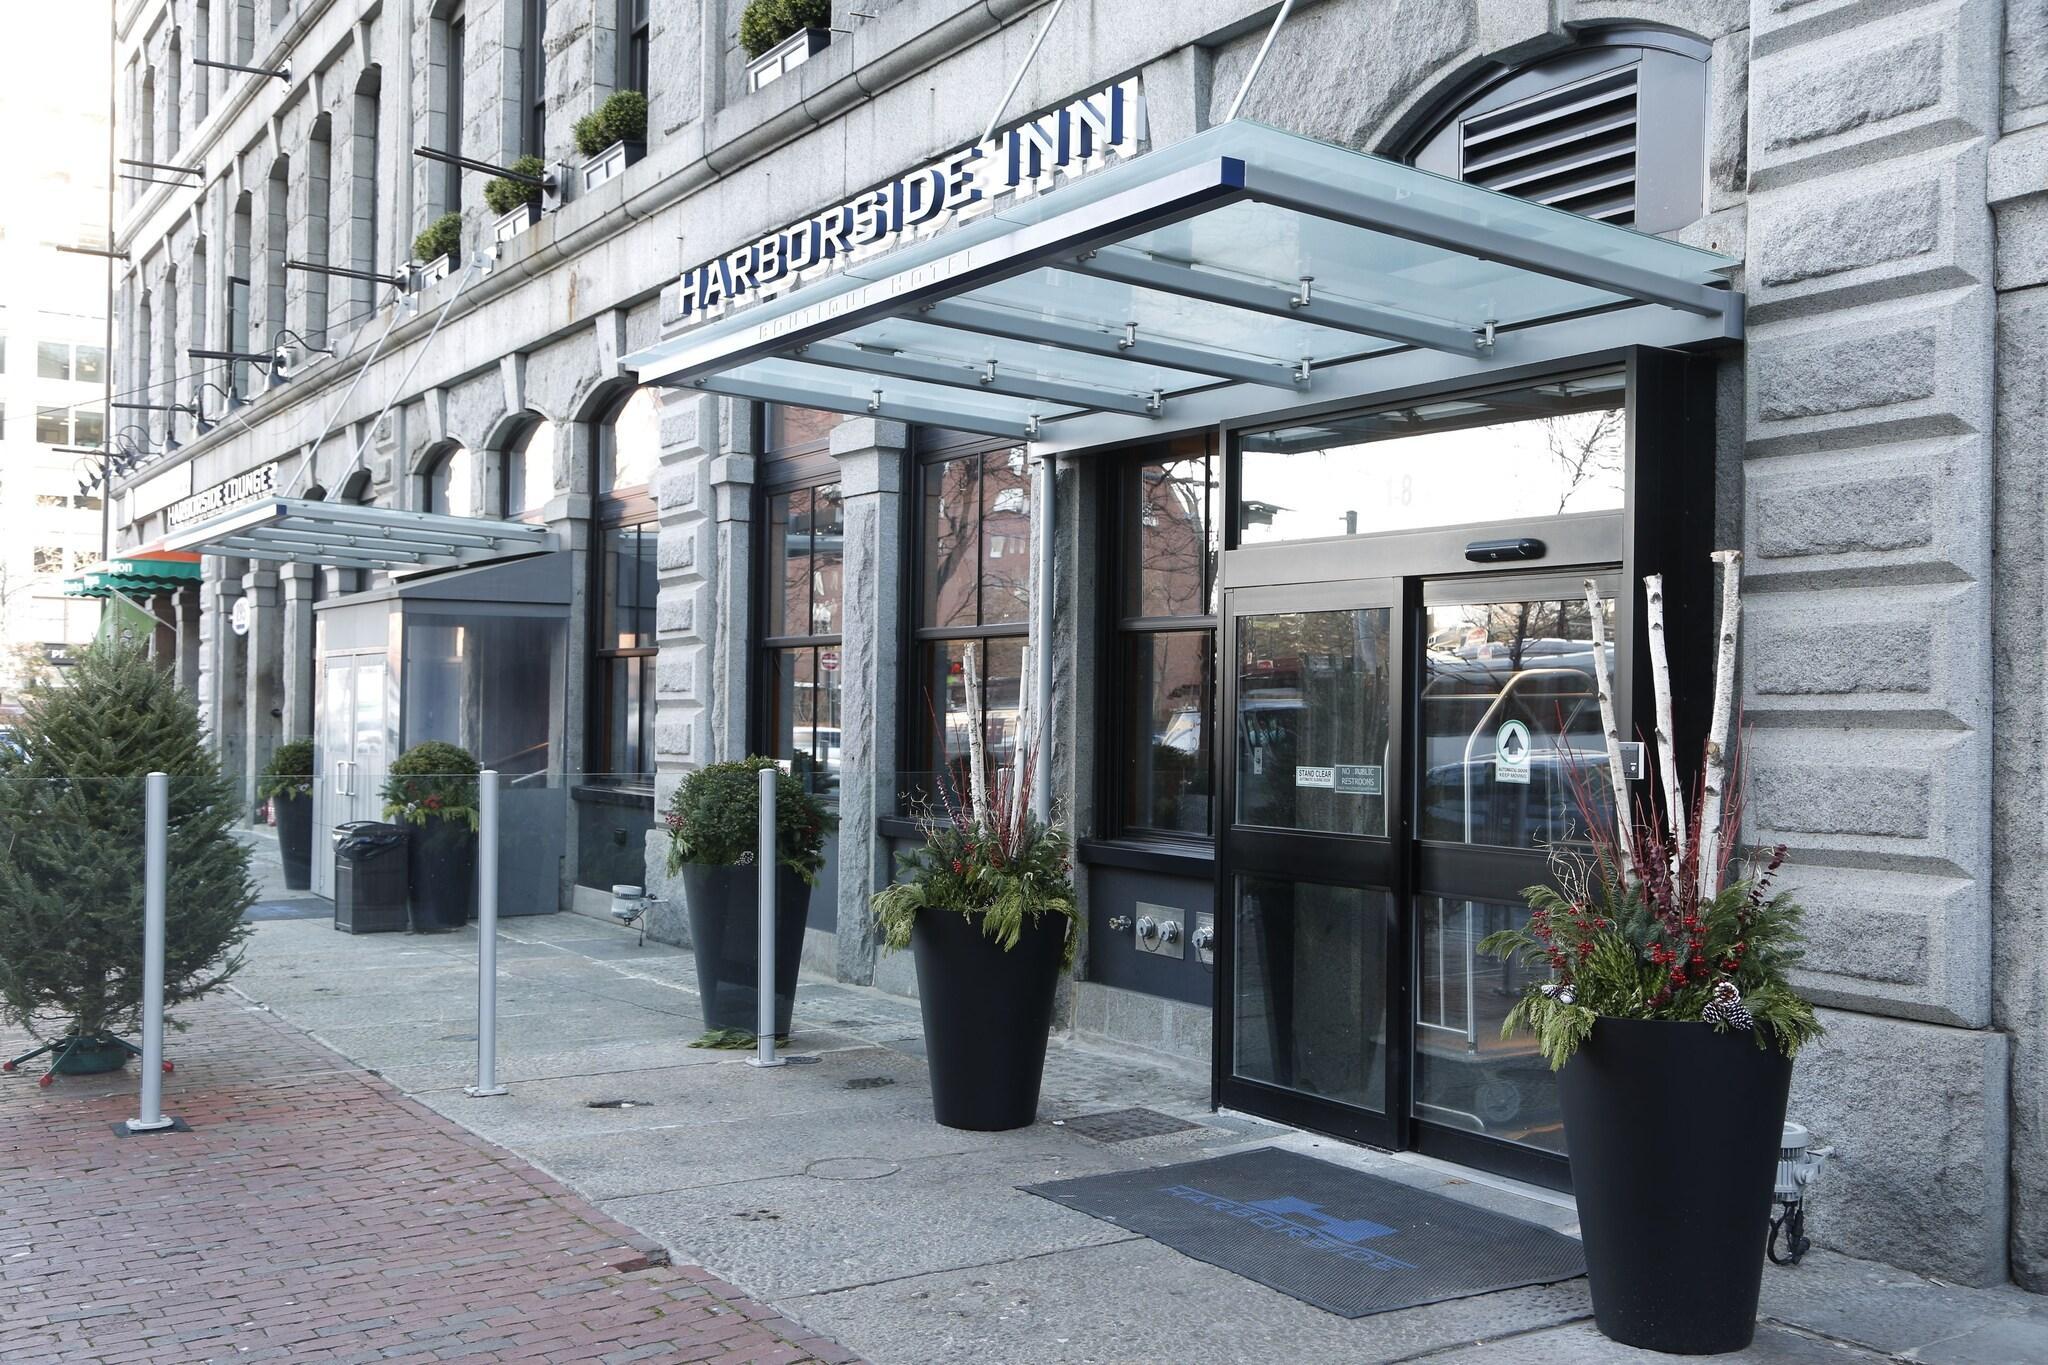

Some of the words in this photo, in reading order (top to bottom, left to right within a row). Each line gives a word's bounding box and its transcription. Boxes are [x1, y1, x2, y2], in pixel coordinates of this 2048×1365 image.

[679, 147, 983, 315] HARBORSIDE
[1002, 85, 1125, 188] INN
[758, 288, 875, 340] BOUTIQUE
[891, 250, 978, 294] HOTEL
[168, 485, 225, 527] HARBORSIDE
[225, 465, 272, 502] LOUNGE
[1315, 770, 1331, 778] CLEAR
[1341, 767, 1351, 776] NO
[1354, 768, 1375, 776] PUBLIC
[1341, 777, 1375, 786] RESTROOMS
